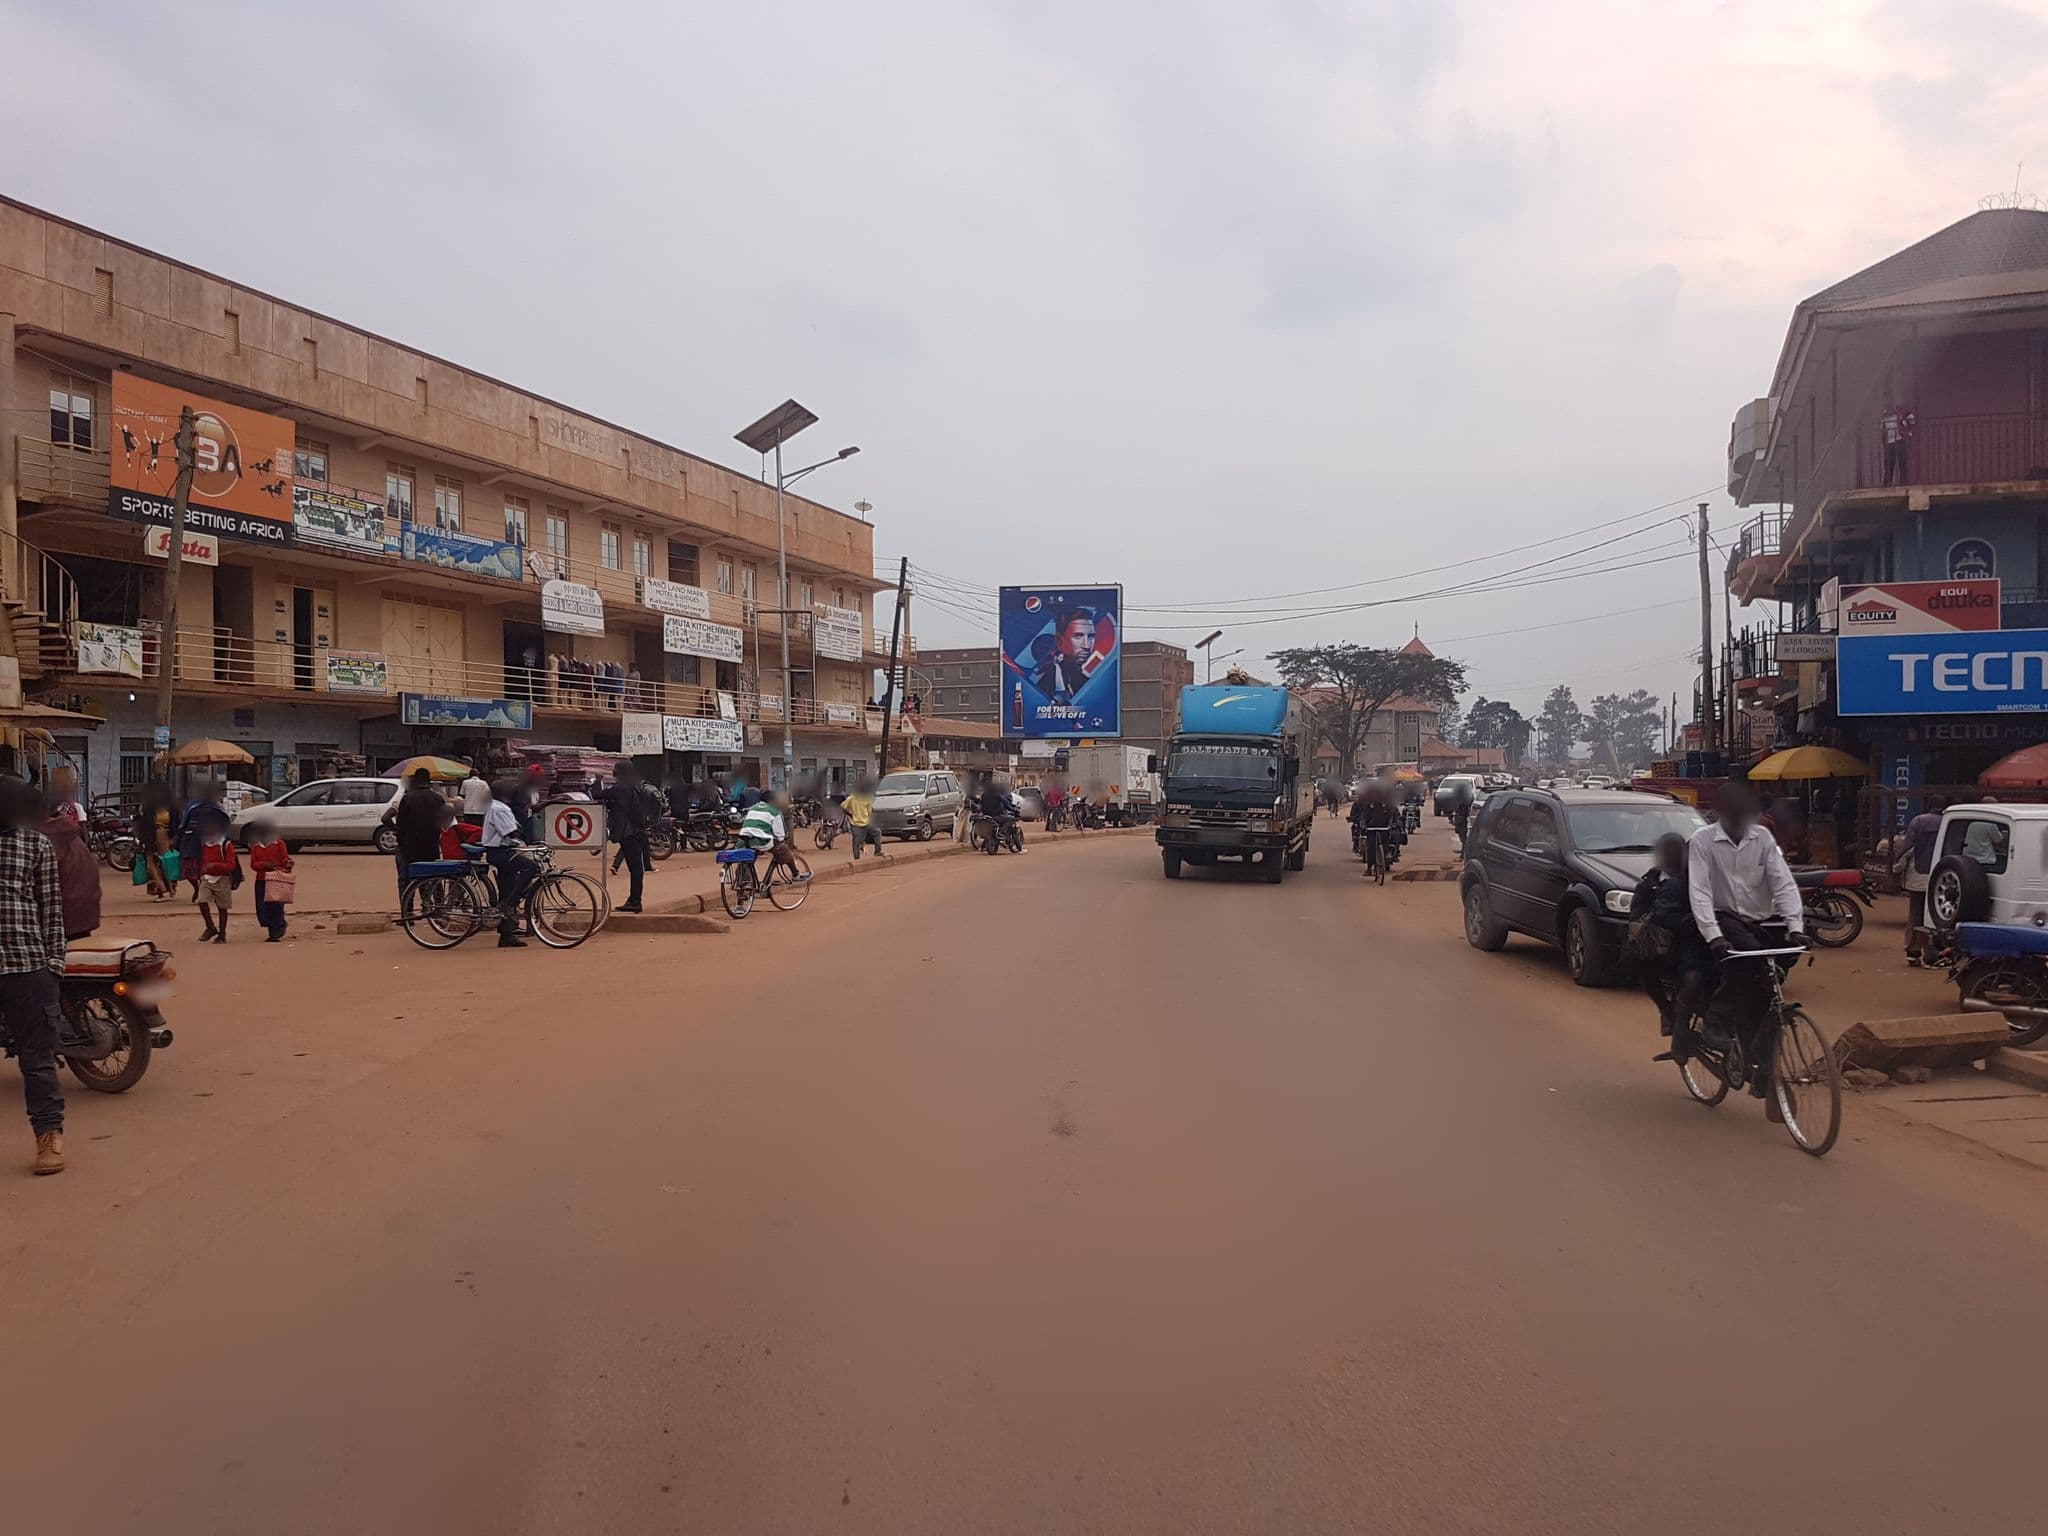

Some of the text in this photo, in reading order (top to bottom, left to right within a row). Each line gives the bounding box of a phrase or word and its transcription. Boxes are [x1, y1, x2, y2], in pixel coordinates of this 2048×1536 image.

[121, 496, 175, 520] SPORTS
[184, 508, 236, 531] BETTING
[239, 520, 285, 541] AFRICA
[410, 522, 453, 540] NICOLAS
[655, 589, 673, 598] HOTEL
[667, 583, 686, 594] LAND
[1940, 588, 1968, 597] EQUI
[1927, 590, 1994, 609] duuka
[1850, 610, 1894, 621] EQUITY
[672, 617, 738, 639] MUTA KITCHENWARE
[1037, 704, 1066, 713] FOR THE
[1047, 711, 1066, 719] LOVE
[1067, 711, 1078, 719] OF
[672, 718, 691, 727] MUTA
[1921, 723, 1998, 739] TECNO
